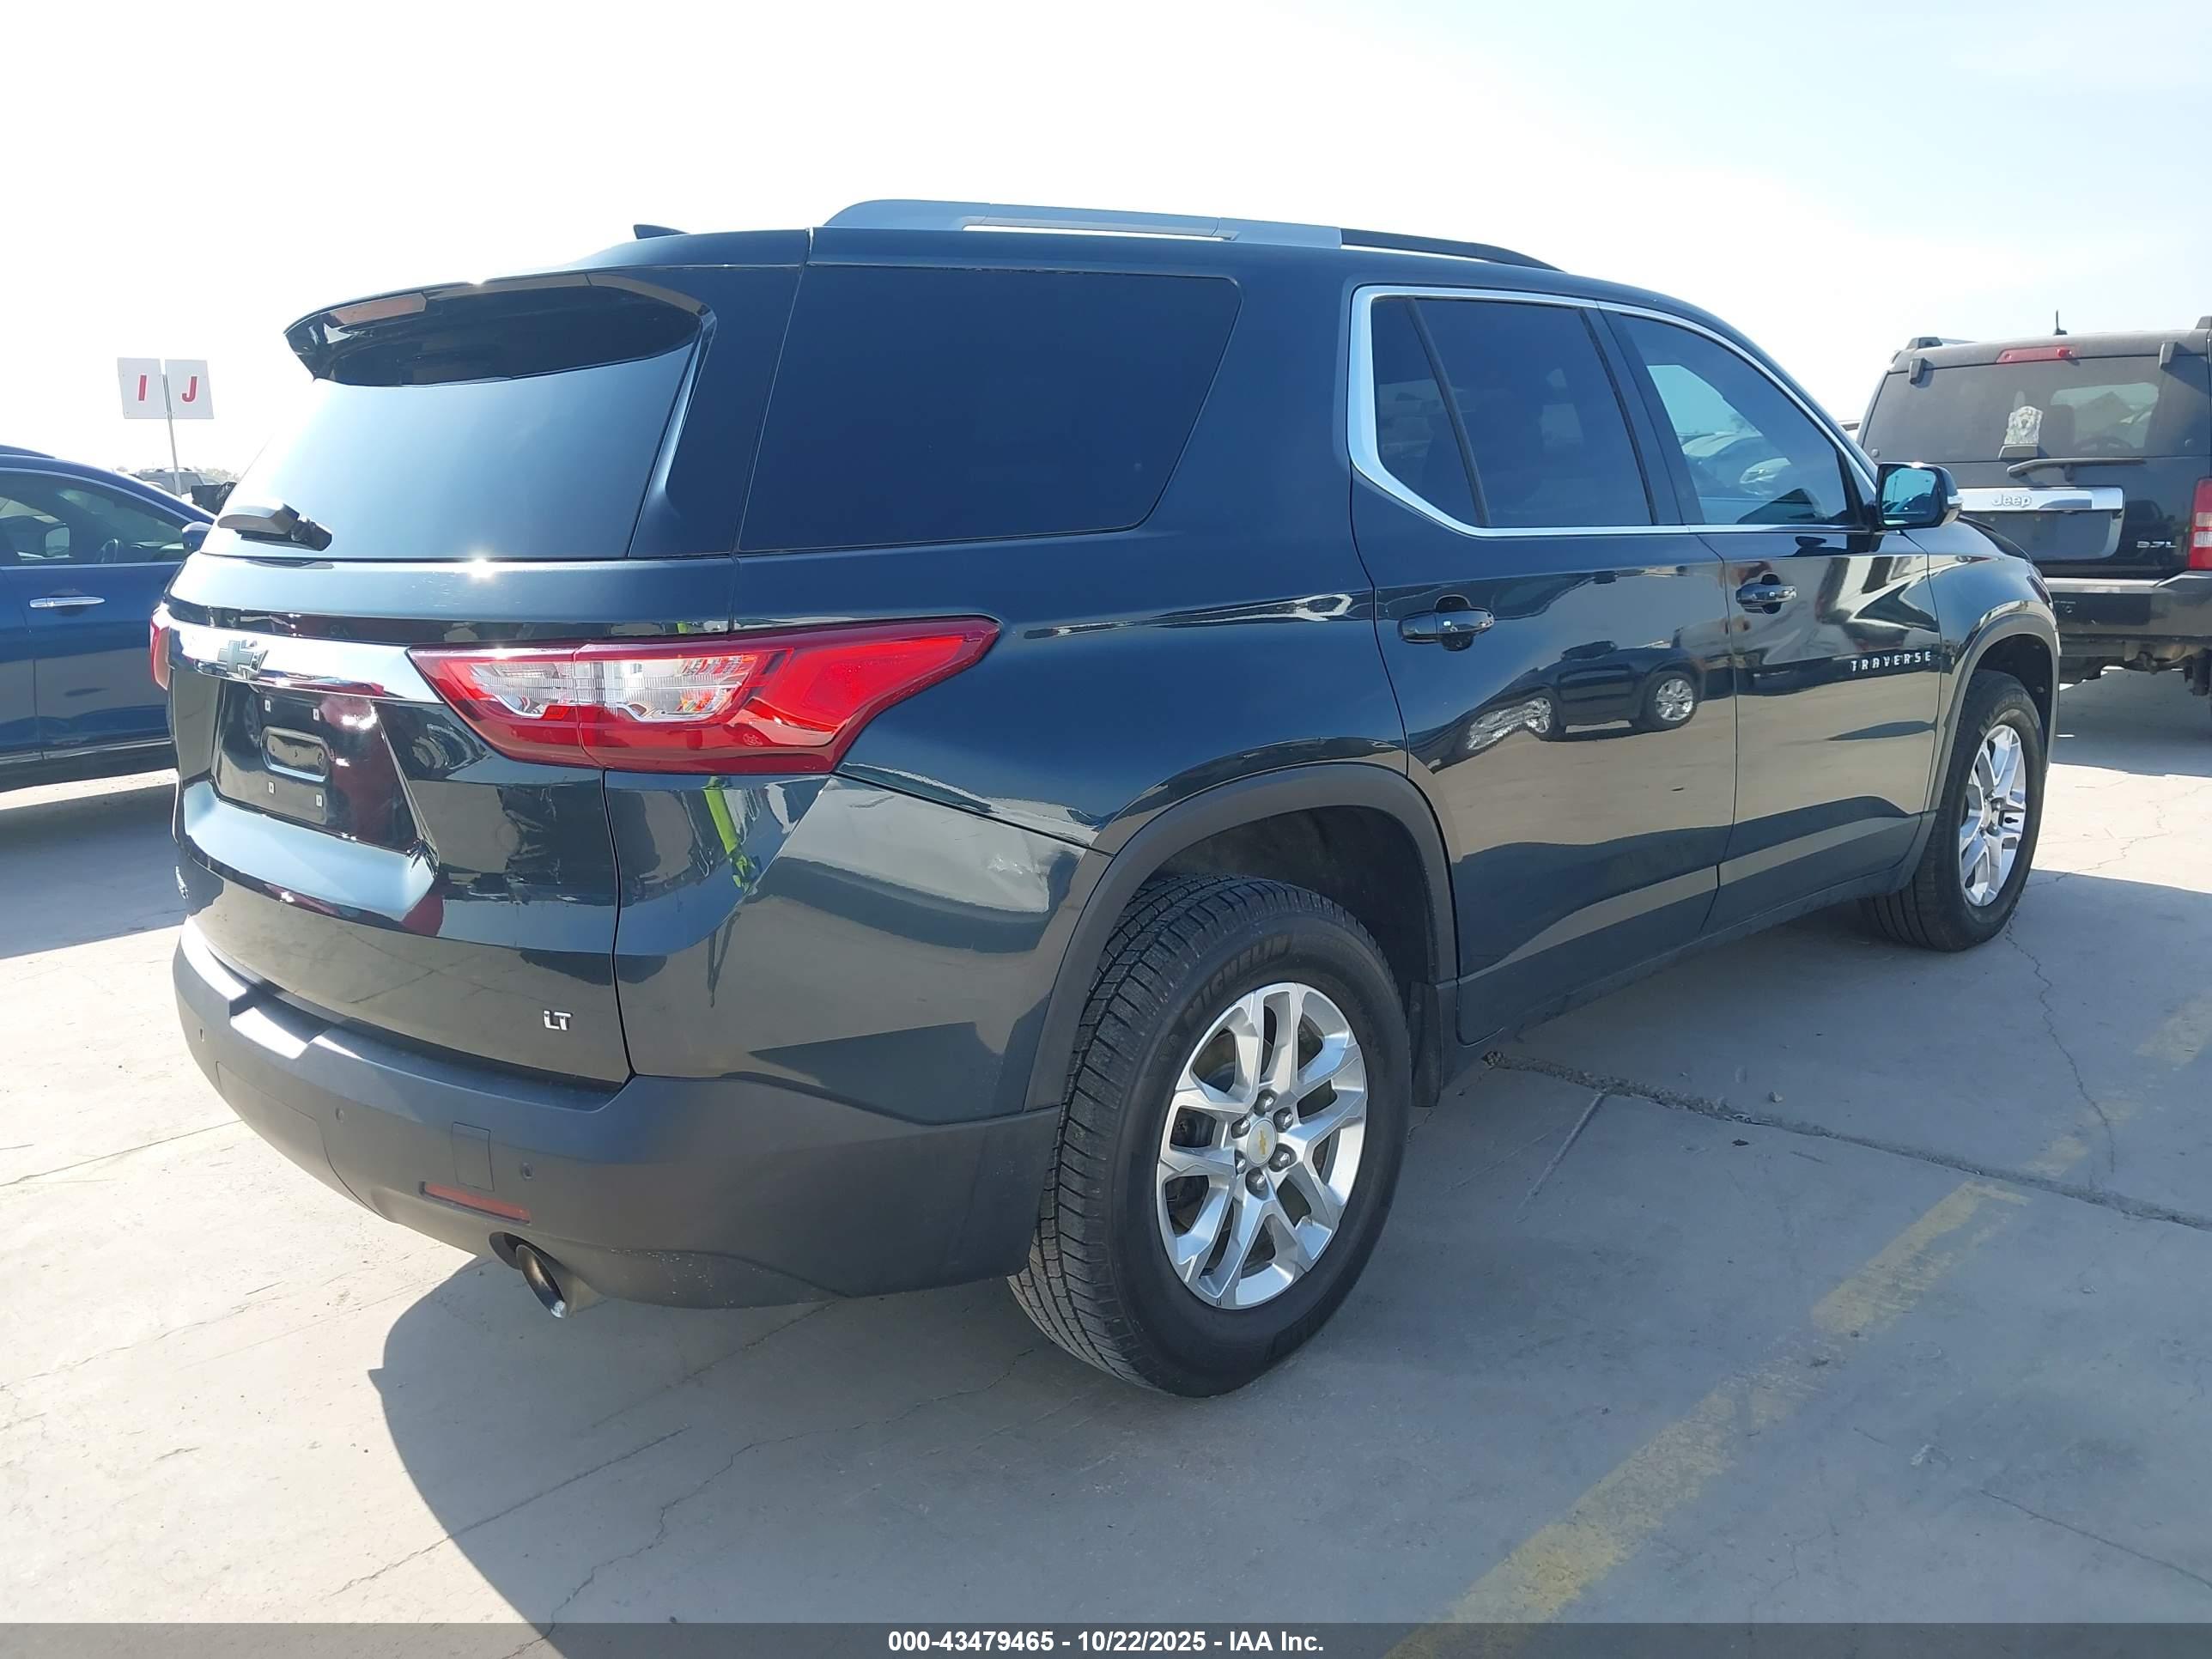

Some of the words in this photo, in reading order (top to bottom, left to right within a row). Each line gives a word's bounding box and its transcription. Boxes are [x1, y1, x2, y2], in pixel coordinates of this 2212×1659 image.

[138, 374, 147, 401] I
[181, 376, 198, 403] J
[1991, 495, 2033, 508] Jeep
[1850, 651, 1931, 672] TRAVERSE
[543, 1010, 573, 1030] LT
